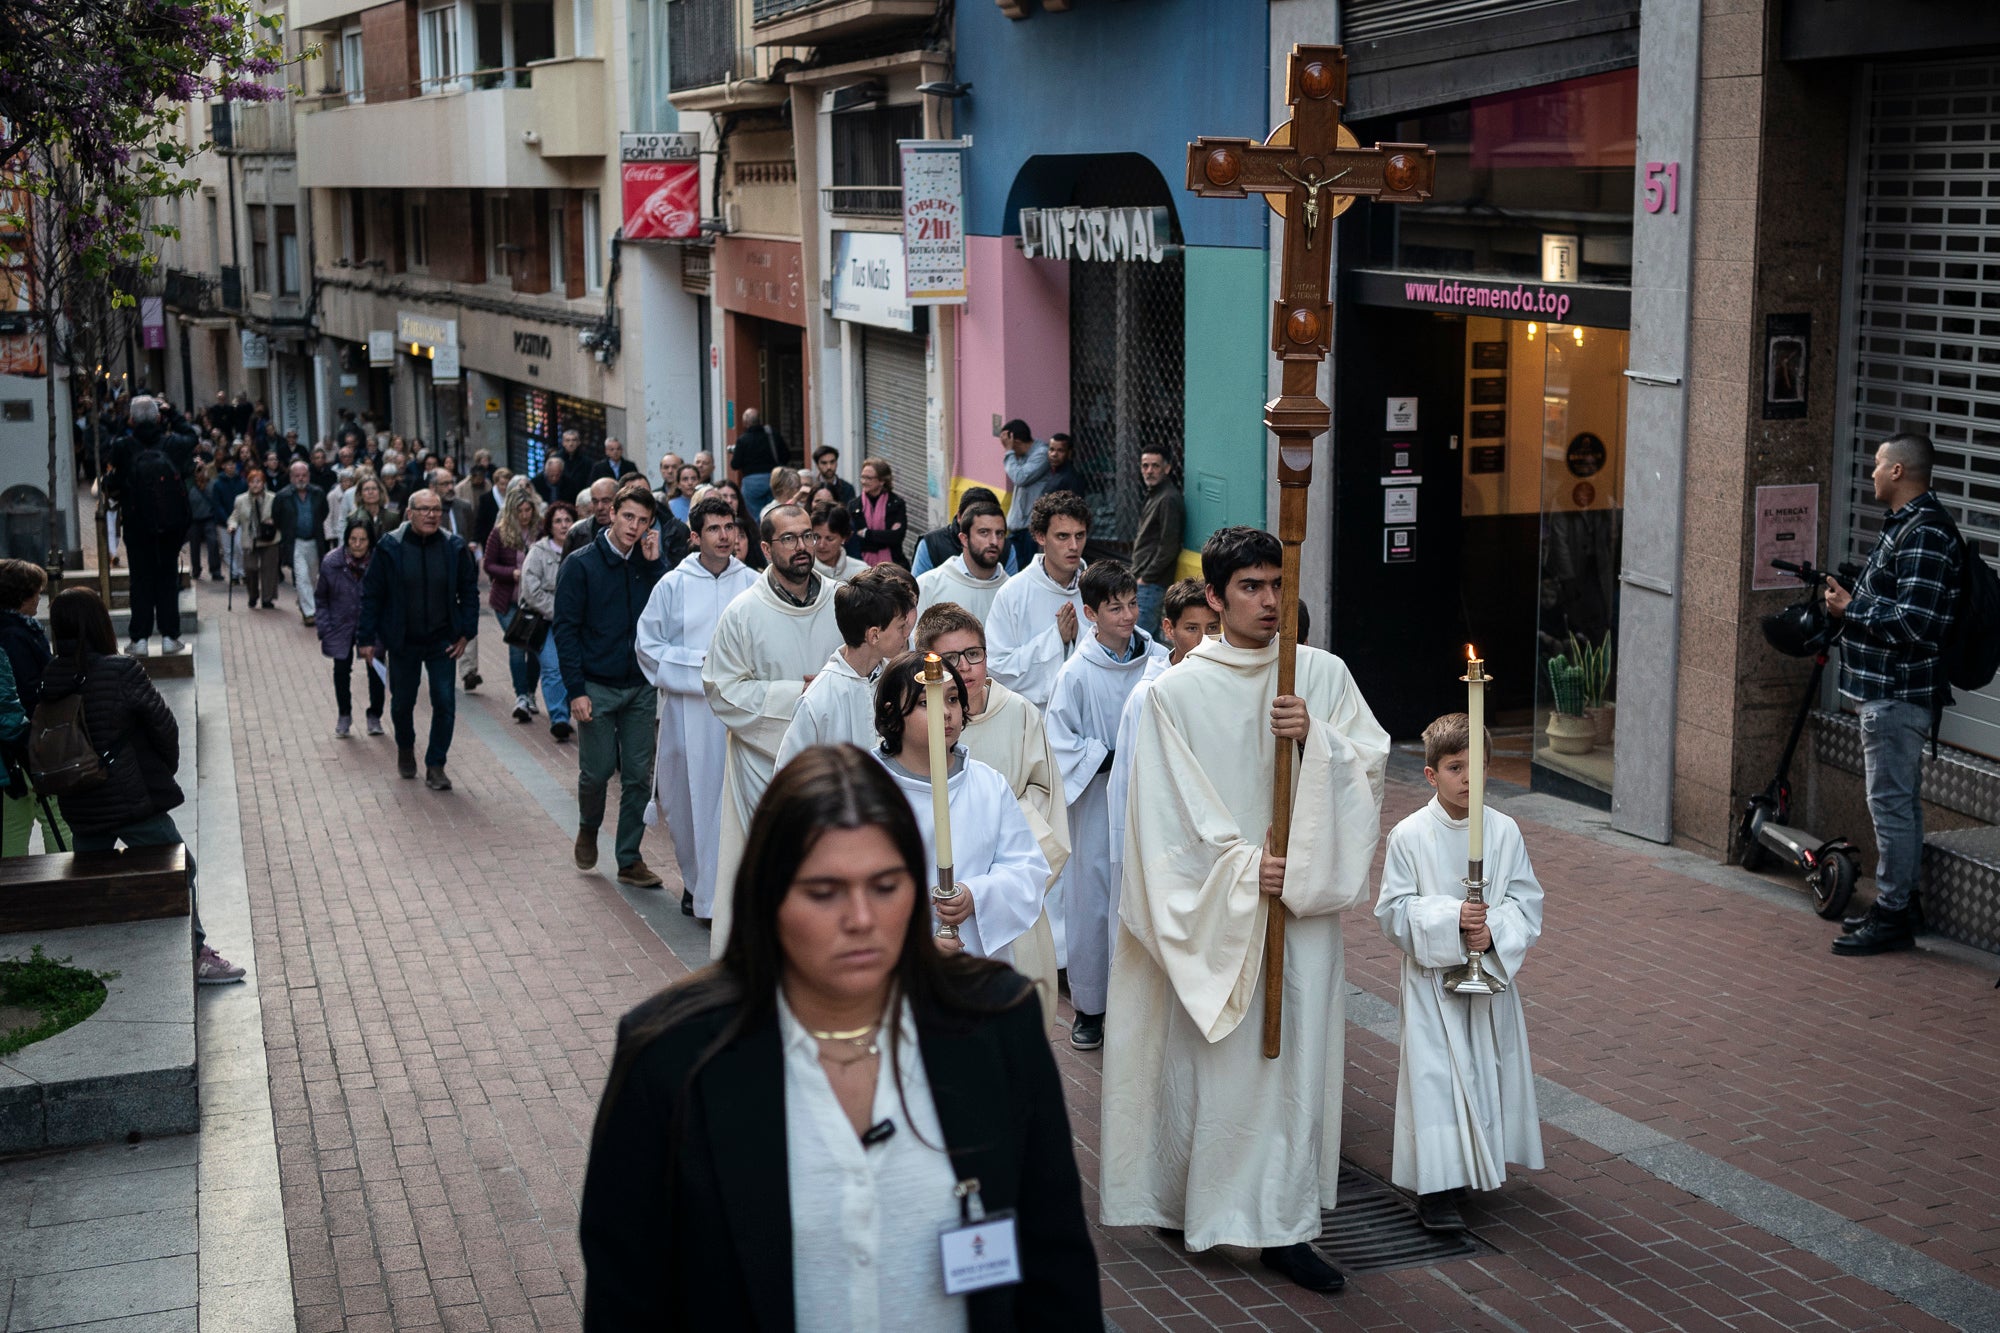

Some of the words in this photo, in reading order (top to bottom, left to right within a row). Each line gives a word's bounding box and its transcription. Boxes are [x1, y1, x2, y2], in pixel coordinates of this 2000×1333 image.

[637, 136, 684, 147] NOVA
[623, 147, 656, 159] FONT
[661, 147, 698, 158] VELLA
[1644, 161, 1680, 214] 51
[908, 198, 958, 217] OBERT
[917, 217, 951, 240] 24H
[851, 258, 865, 287] Tus
[867, 258, 890, 290] Nails
[1405, 279, 1570, 320] www.latremenda.top
[1764, 508, 1774, 517] EL
[1776, 507, 1809, 516] MERCAT
